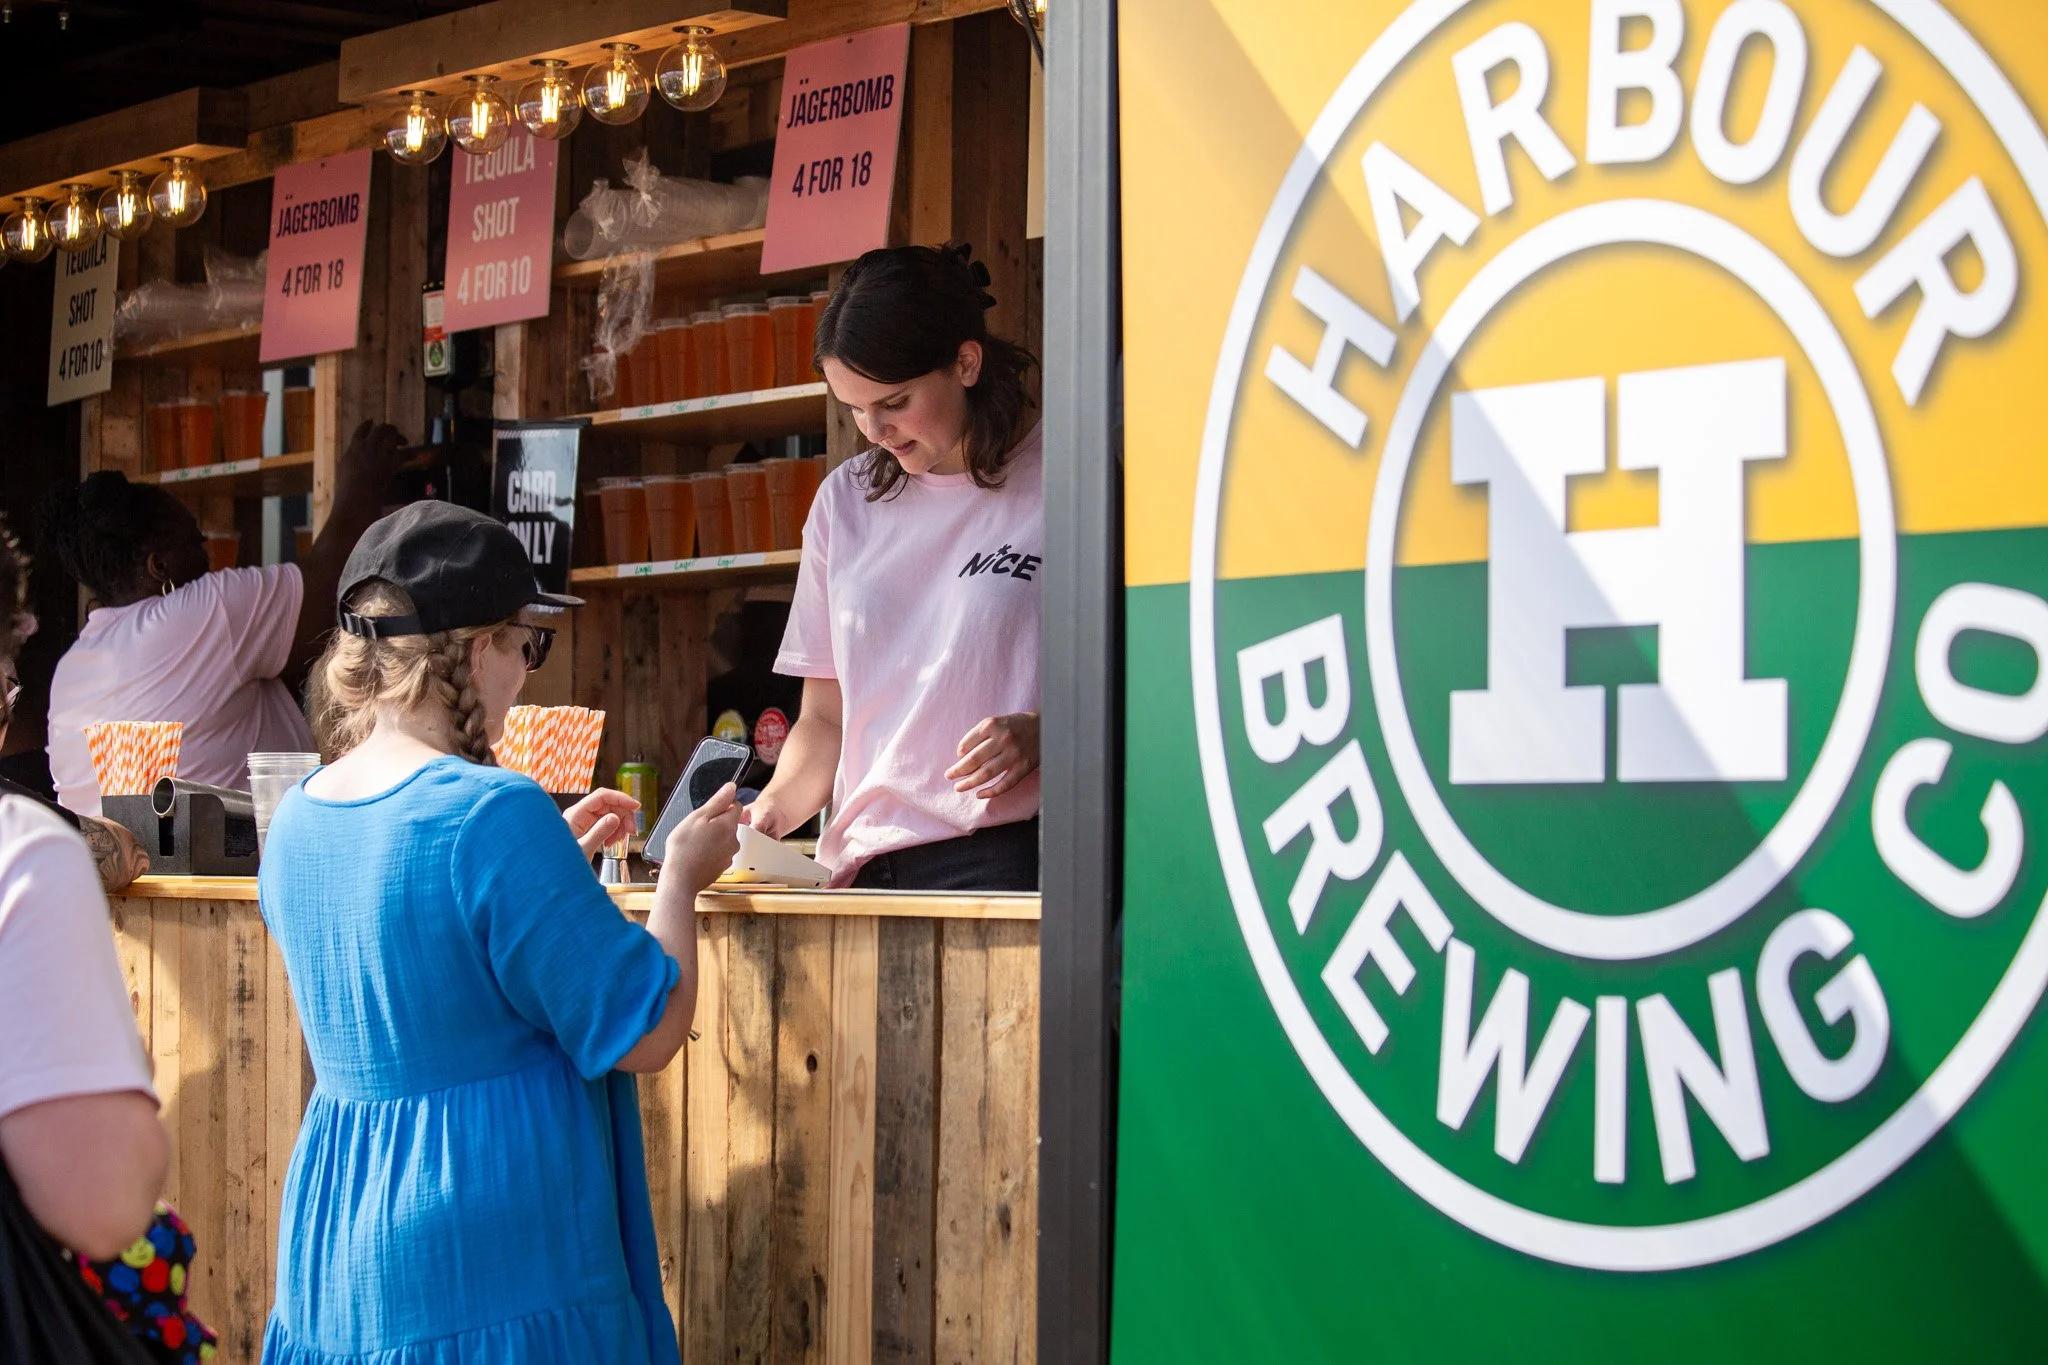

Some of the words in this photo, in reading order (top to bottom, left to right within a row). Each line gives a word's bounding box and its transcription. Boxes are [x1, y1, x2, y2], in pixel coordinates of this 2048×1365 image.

[786, 74, 895, 129] JÄGERBOMB
[465, 133, 536, 185] TEQUILA
[792, 163, 805, 198] 4
[808, 156, 844, 196] FOR
[851, 150, 873, 188] 18
[275, 192, 360, 238] JÄGERBOMB
[472, 196, 520, 243] SHOT
[1262, 0, 2020, 451] HARBOUR
[65, 233, 107, 277] TEQUILA
[282, 267, 292, 298] 4
[294, 263, 322, 296] FOR
[328, 258, 344, 291] 18
[457, 267, 469, 306] 4
[473, 261, 507, 304] FOR
[510, 255, 532, 296] 10
[69, 288, 98, 327] SHOT
[59, 349, 66, 381] 4
[69, 343, 88, 380] FOR
[90, 338, 103, 375] 10
[507, 470, 557, 514] CARD
[1449, 356, 1788, 786] H
[1236, 612, 1891, 1186] BREWING
[1871, 581, 2048, 919] CO
